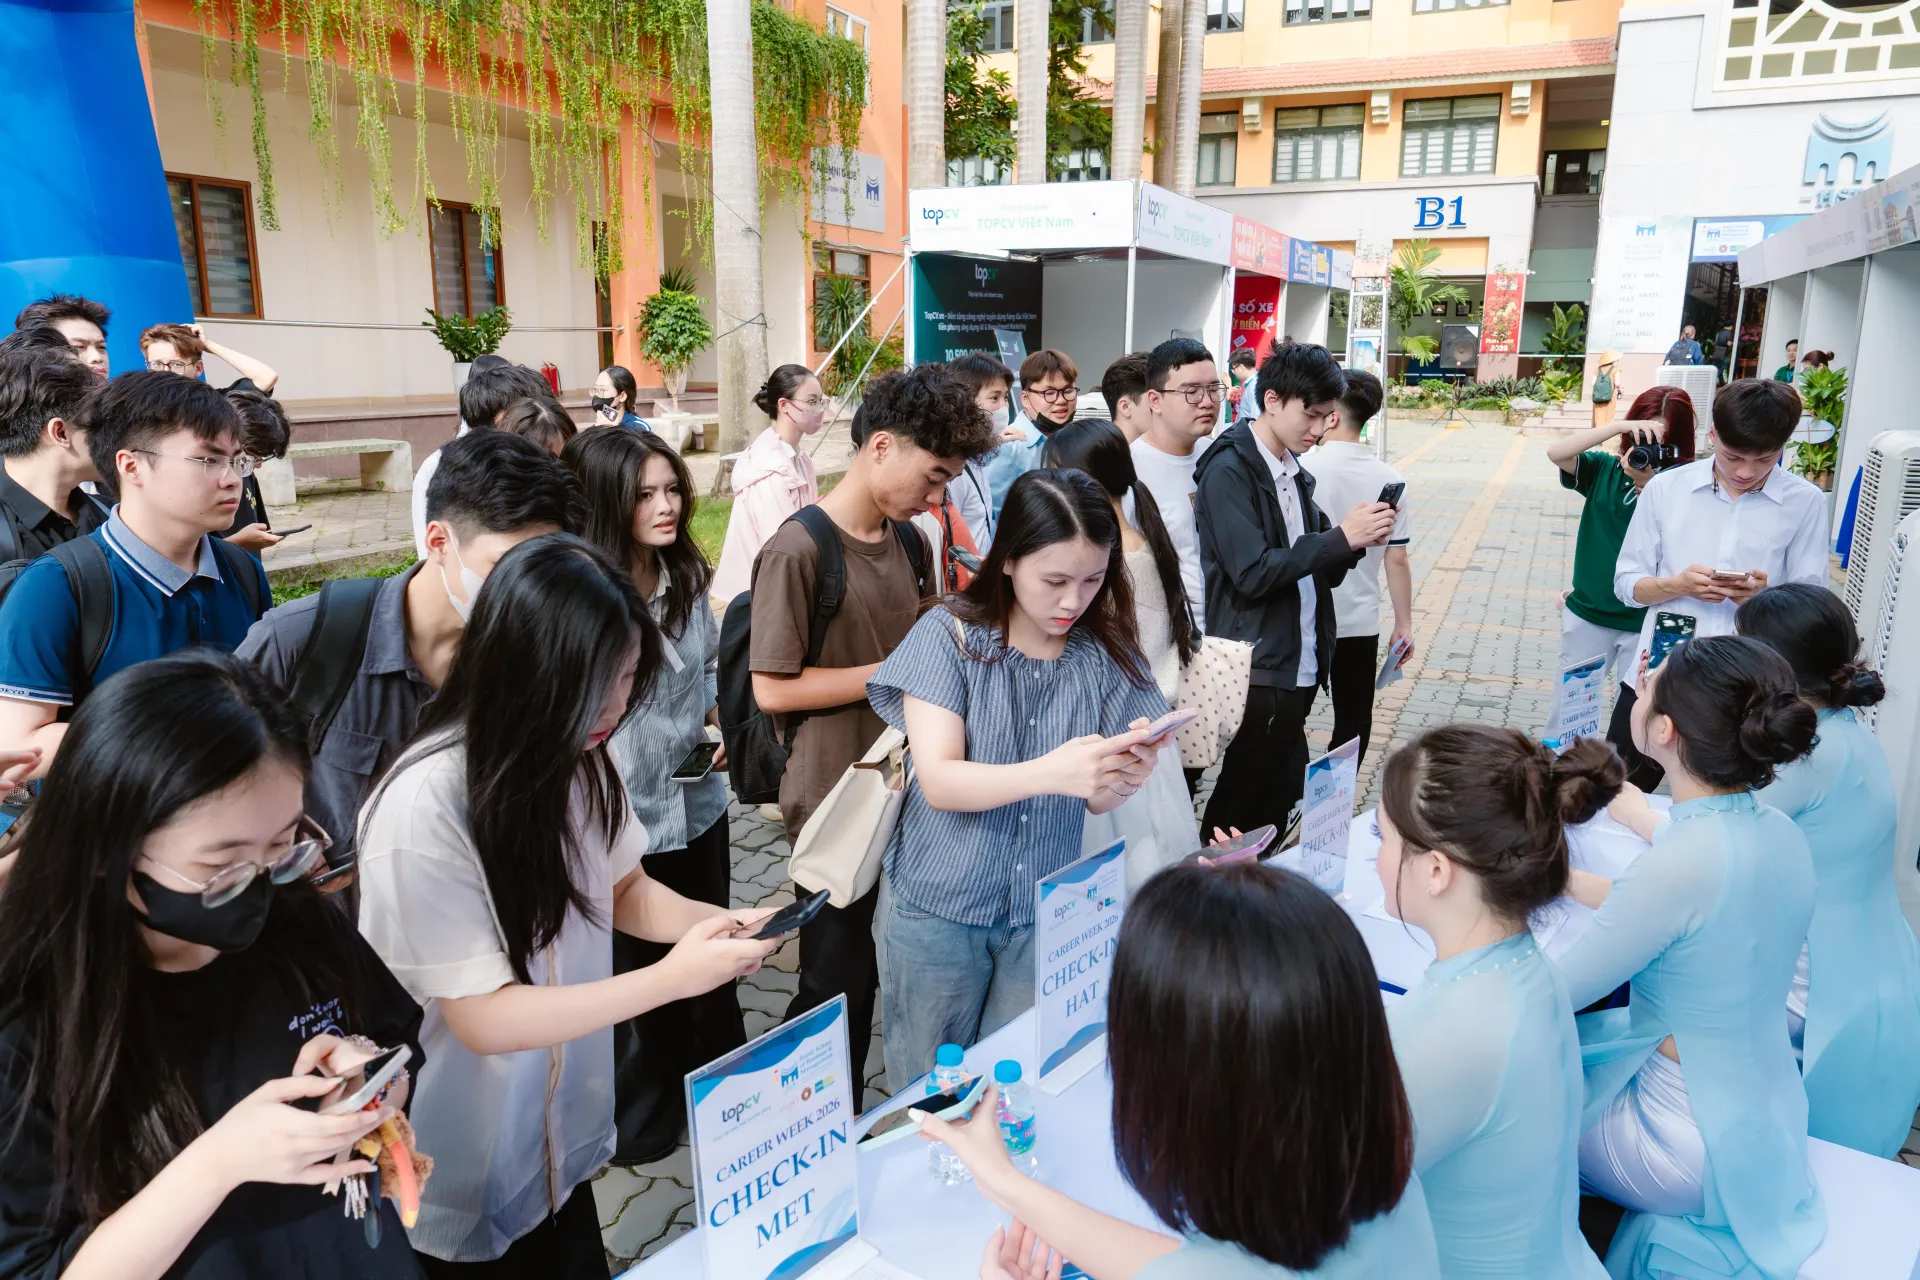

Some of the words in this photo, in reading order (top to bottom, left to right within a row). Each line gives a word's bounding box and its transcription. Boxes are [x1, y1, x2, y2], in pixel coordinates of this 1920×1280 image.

[977, 217, 1015, 231] TOPCV
[1018, 215, 1043, 231] Việt
[1045, 216, 1075, 228] Nam
[1413, 196, 1467, 228] B1
[924, 311, 945, 321] TopCV.vn
[1238, 299, 1256, 313] SỐ
[1258, 302, 1274, 313] XE
[1563, 713, 1579, 726] CAREER
[1308, 813, 1328, 832] CAREER
[1328, 806, 1341, 819] WEEK
[1302, 817, 1351, 859] CHECK-IN
[1313, 852, 1336, 878] MAC
[1048, 936, 1081, 963] CAREER
[1081, 922, 1104, 944] WEEK
[1105, 914, 1119, 929] 2026
[1042, 936, 1118, 997] CHECK-IN
[1065, 980, 1100, 1018] HAT
[288, 1001, 322, 1031] don't
[800, 1053, 833, 1074] Management
[716, 1139, 774, 1183] CAREER
[775, 1112, 814, 1146] WEEK
[816, 1097, 841, 1121] 2026
[709, 1119, 849, 1228] CHECK-IN
[755, 1187, 816, 1250] MET
